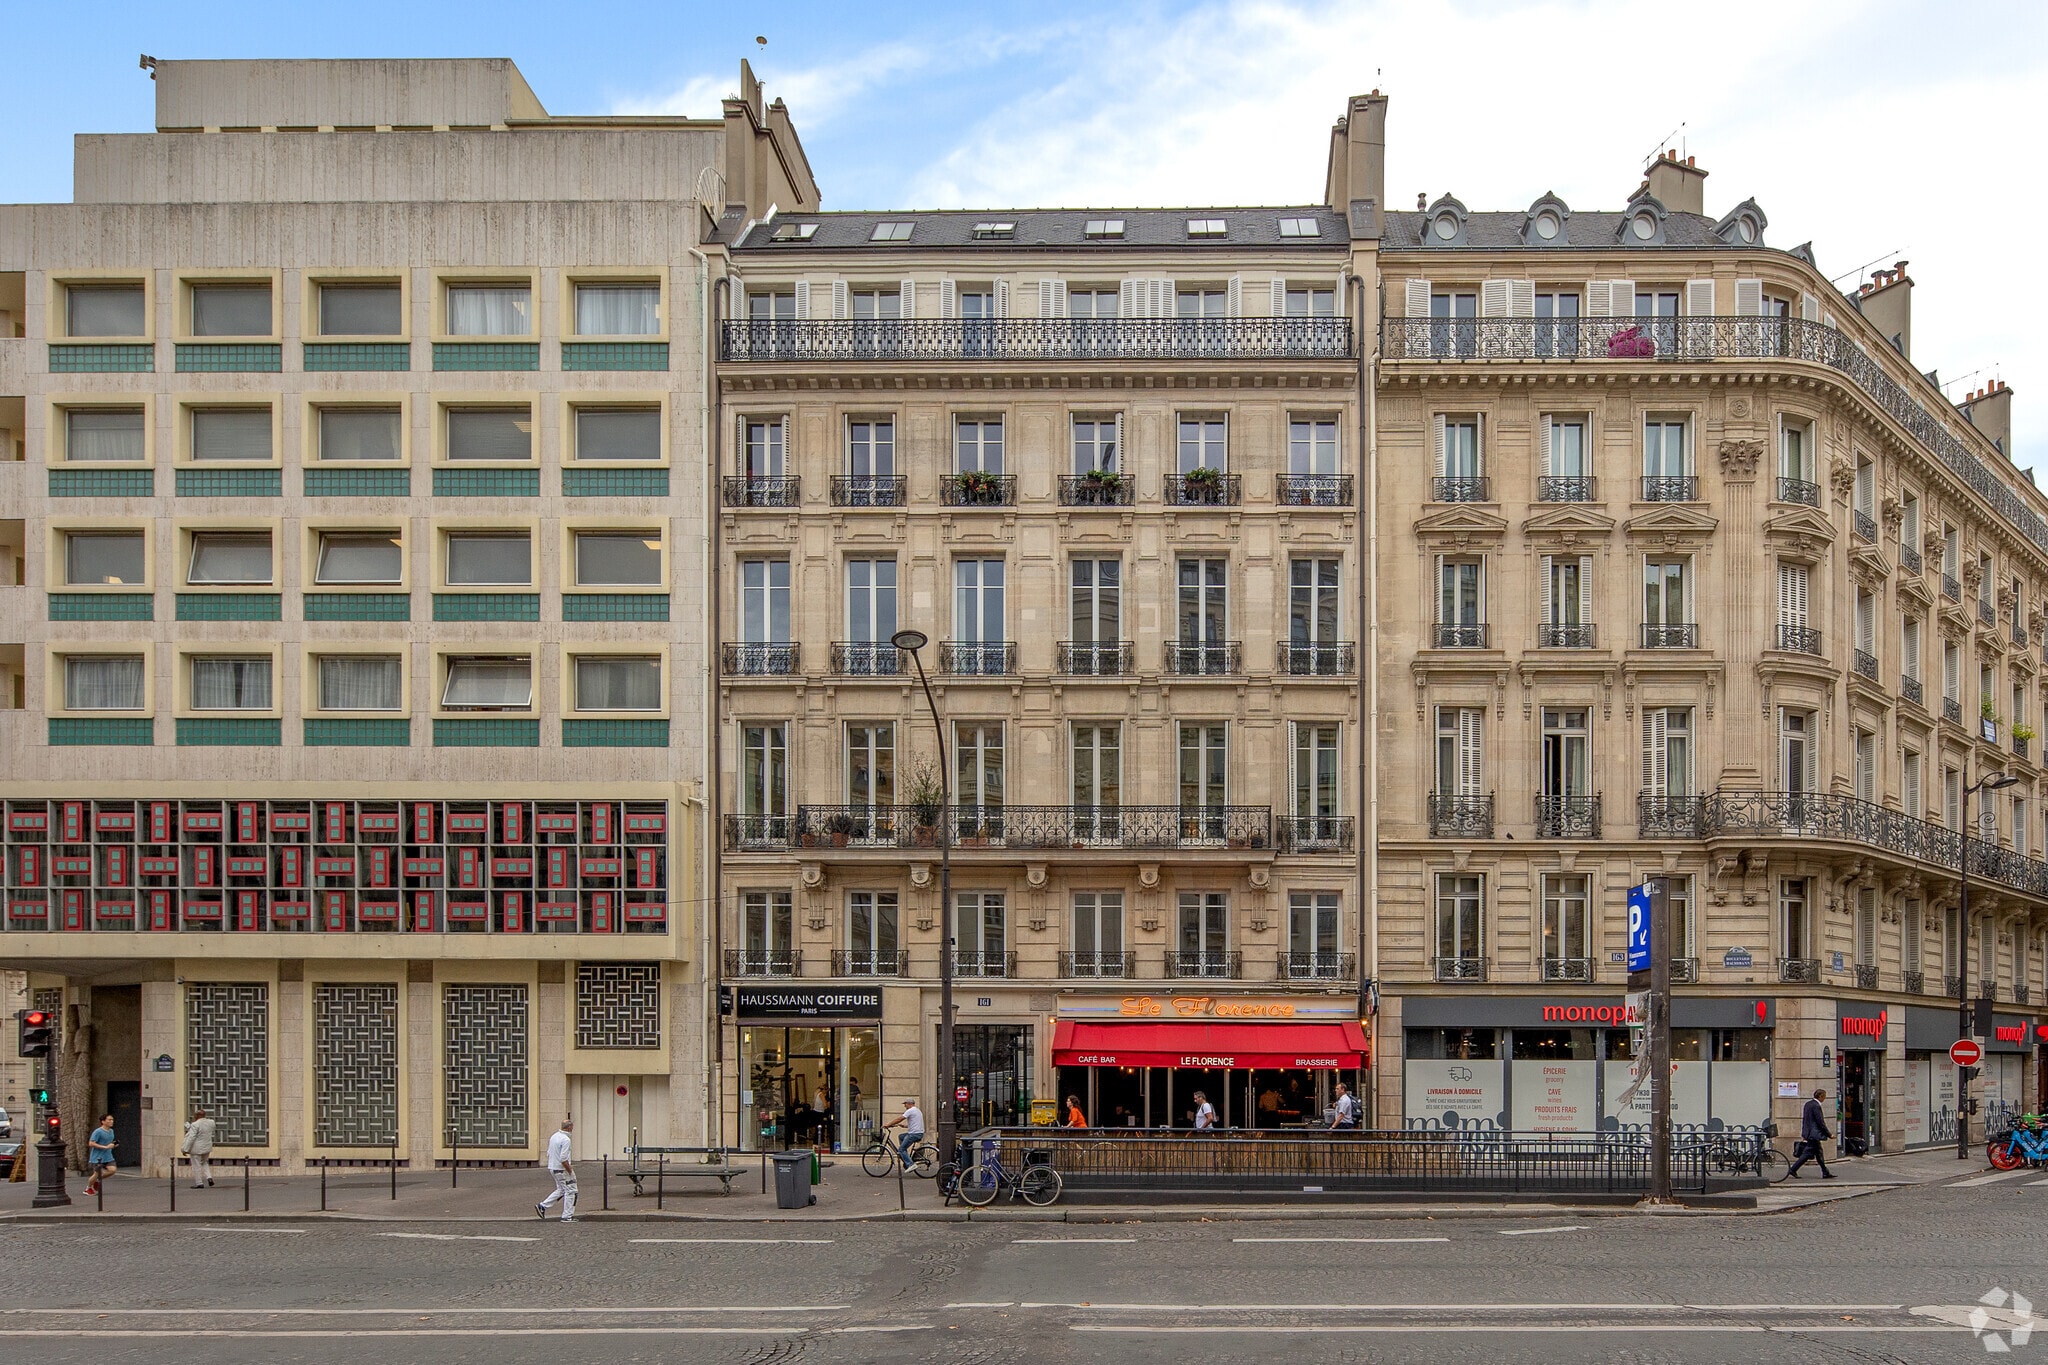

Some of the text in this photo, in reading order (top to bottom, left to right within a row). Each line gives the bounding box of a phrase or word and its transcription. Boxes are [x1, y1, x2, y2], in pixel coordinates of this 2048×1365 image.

[1629, 904, 1642, 947] P
[1612, 953, 1624, 961] 163
[741, 995, 814, 1006] HAUSSMANN
[817, 995, 878, 1006] COIFFURE
[1121, 997, 1295, 1016] Le Florence
[1543, 1002, 1627, 1027] monop
[1078, 1055, 1098, 1063] CAFÉ
[1181, 1057, 1234, 1066] LE FLORENCE
[1295, 1059, 1338, 1067] BRASSERIE
[1543, 1067, 1567, 1075] ÉPICERIE
[1454, 1087, 1457, 1095] À
